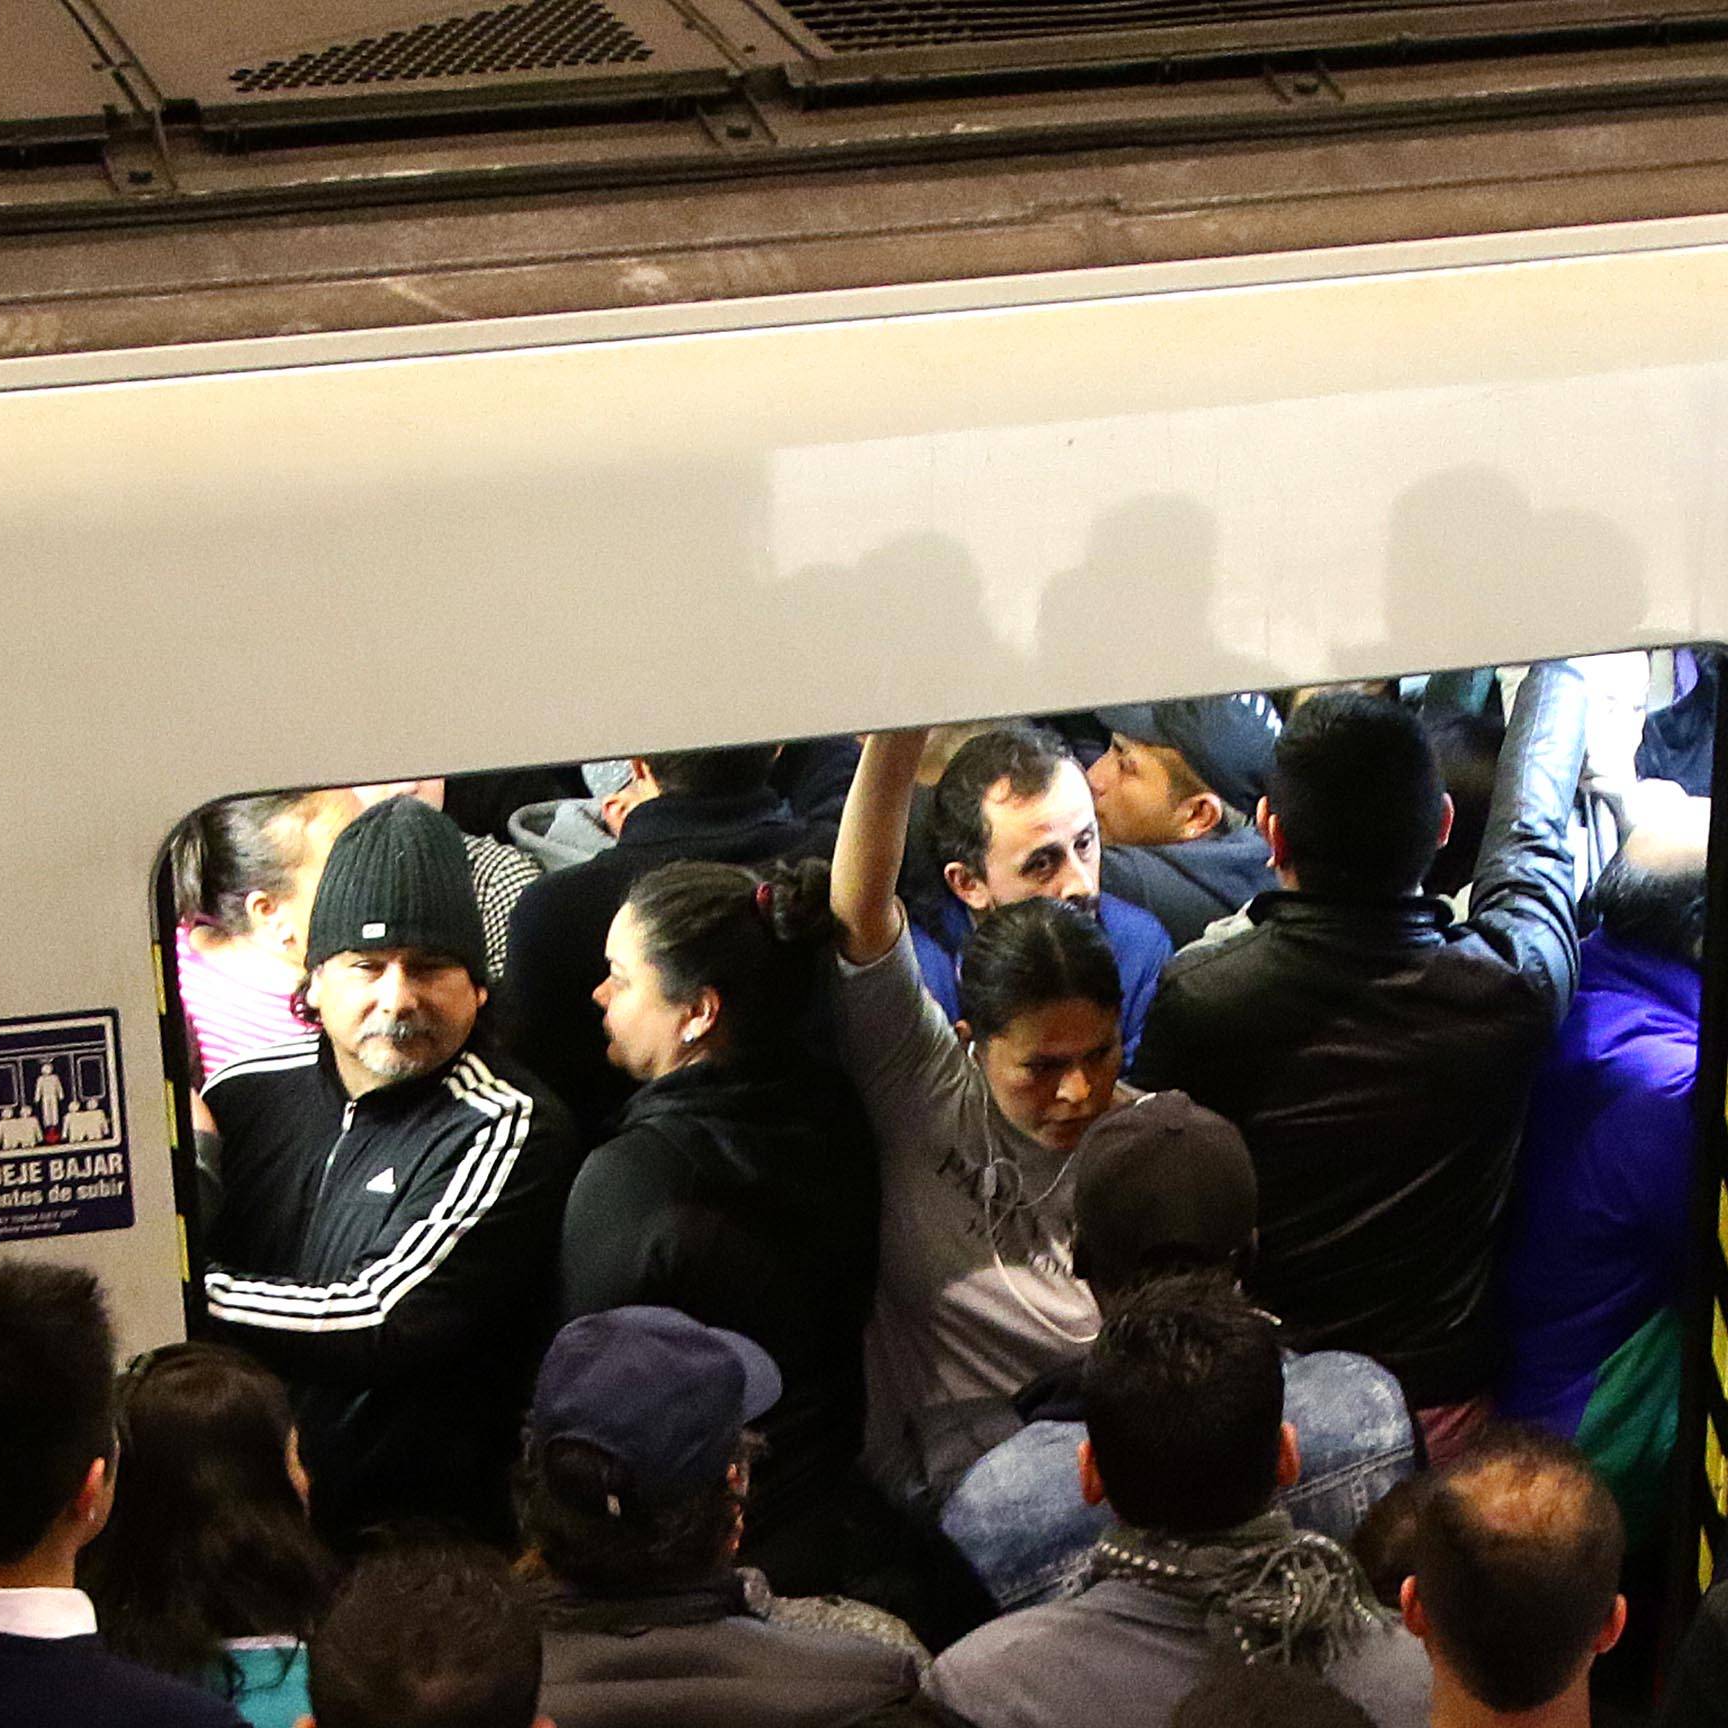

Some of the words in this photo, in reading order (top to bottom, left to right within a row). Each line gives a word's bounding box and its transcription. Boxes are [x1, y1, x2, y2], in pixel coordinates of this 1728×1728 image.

[50, 1153, 124, 1182] BAJAR
[48, 1184, 72, 1202] de
[75, 1179, 126, 1200] subir
